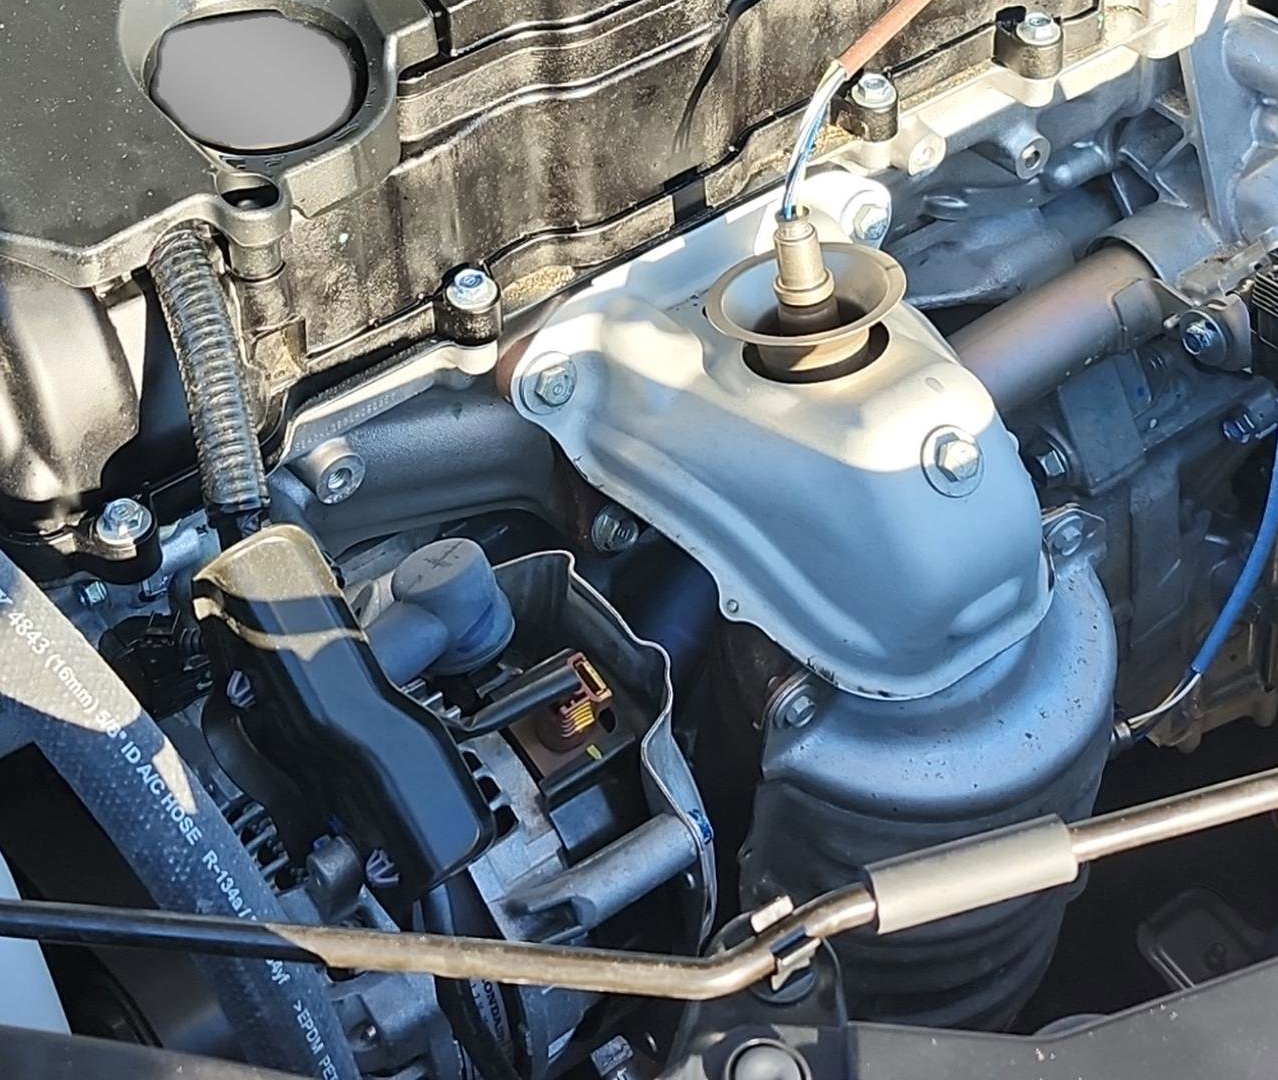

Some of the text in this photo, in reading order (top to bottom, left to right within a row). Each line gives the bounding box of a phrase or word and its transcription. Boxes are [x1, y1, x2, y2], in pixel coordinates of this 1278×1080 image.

[7, 610, 51, 655] 4843
[44, 653, 100, 714] (16mm)
[120, 740, 143, 765] ID
[136, 762, 166, 796] A/C
[160, 793, 204, 847] HOSE
[201, 849, 244, 913] R-134a
[482, 978, 502, 1027] ONDA
